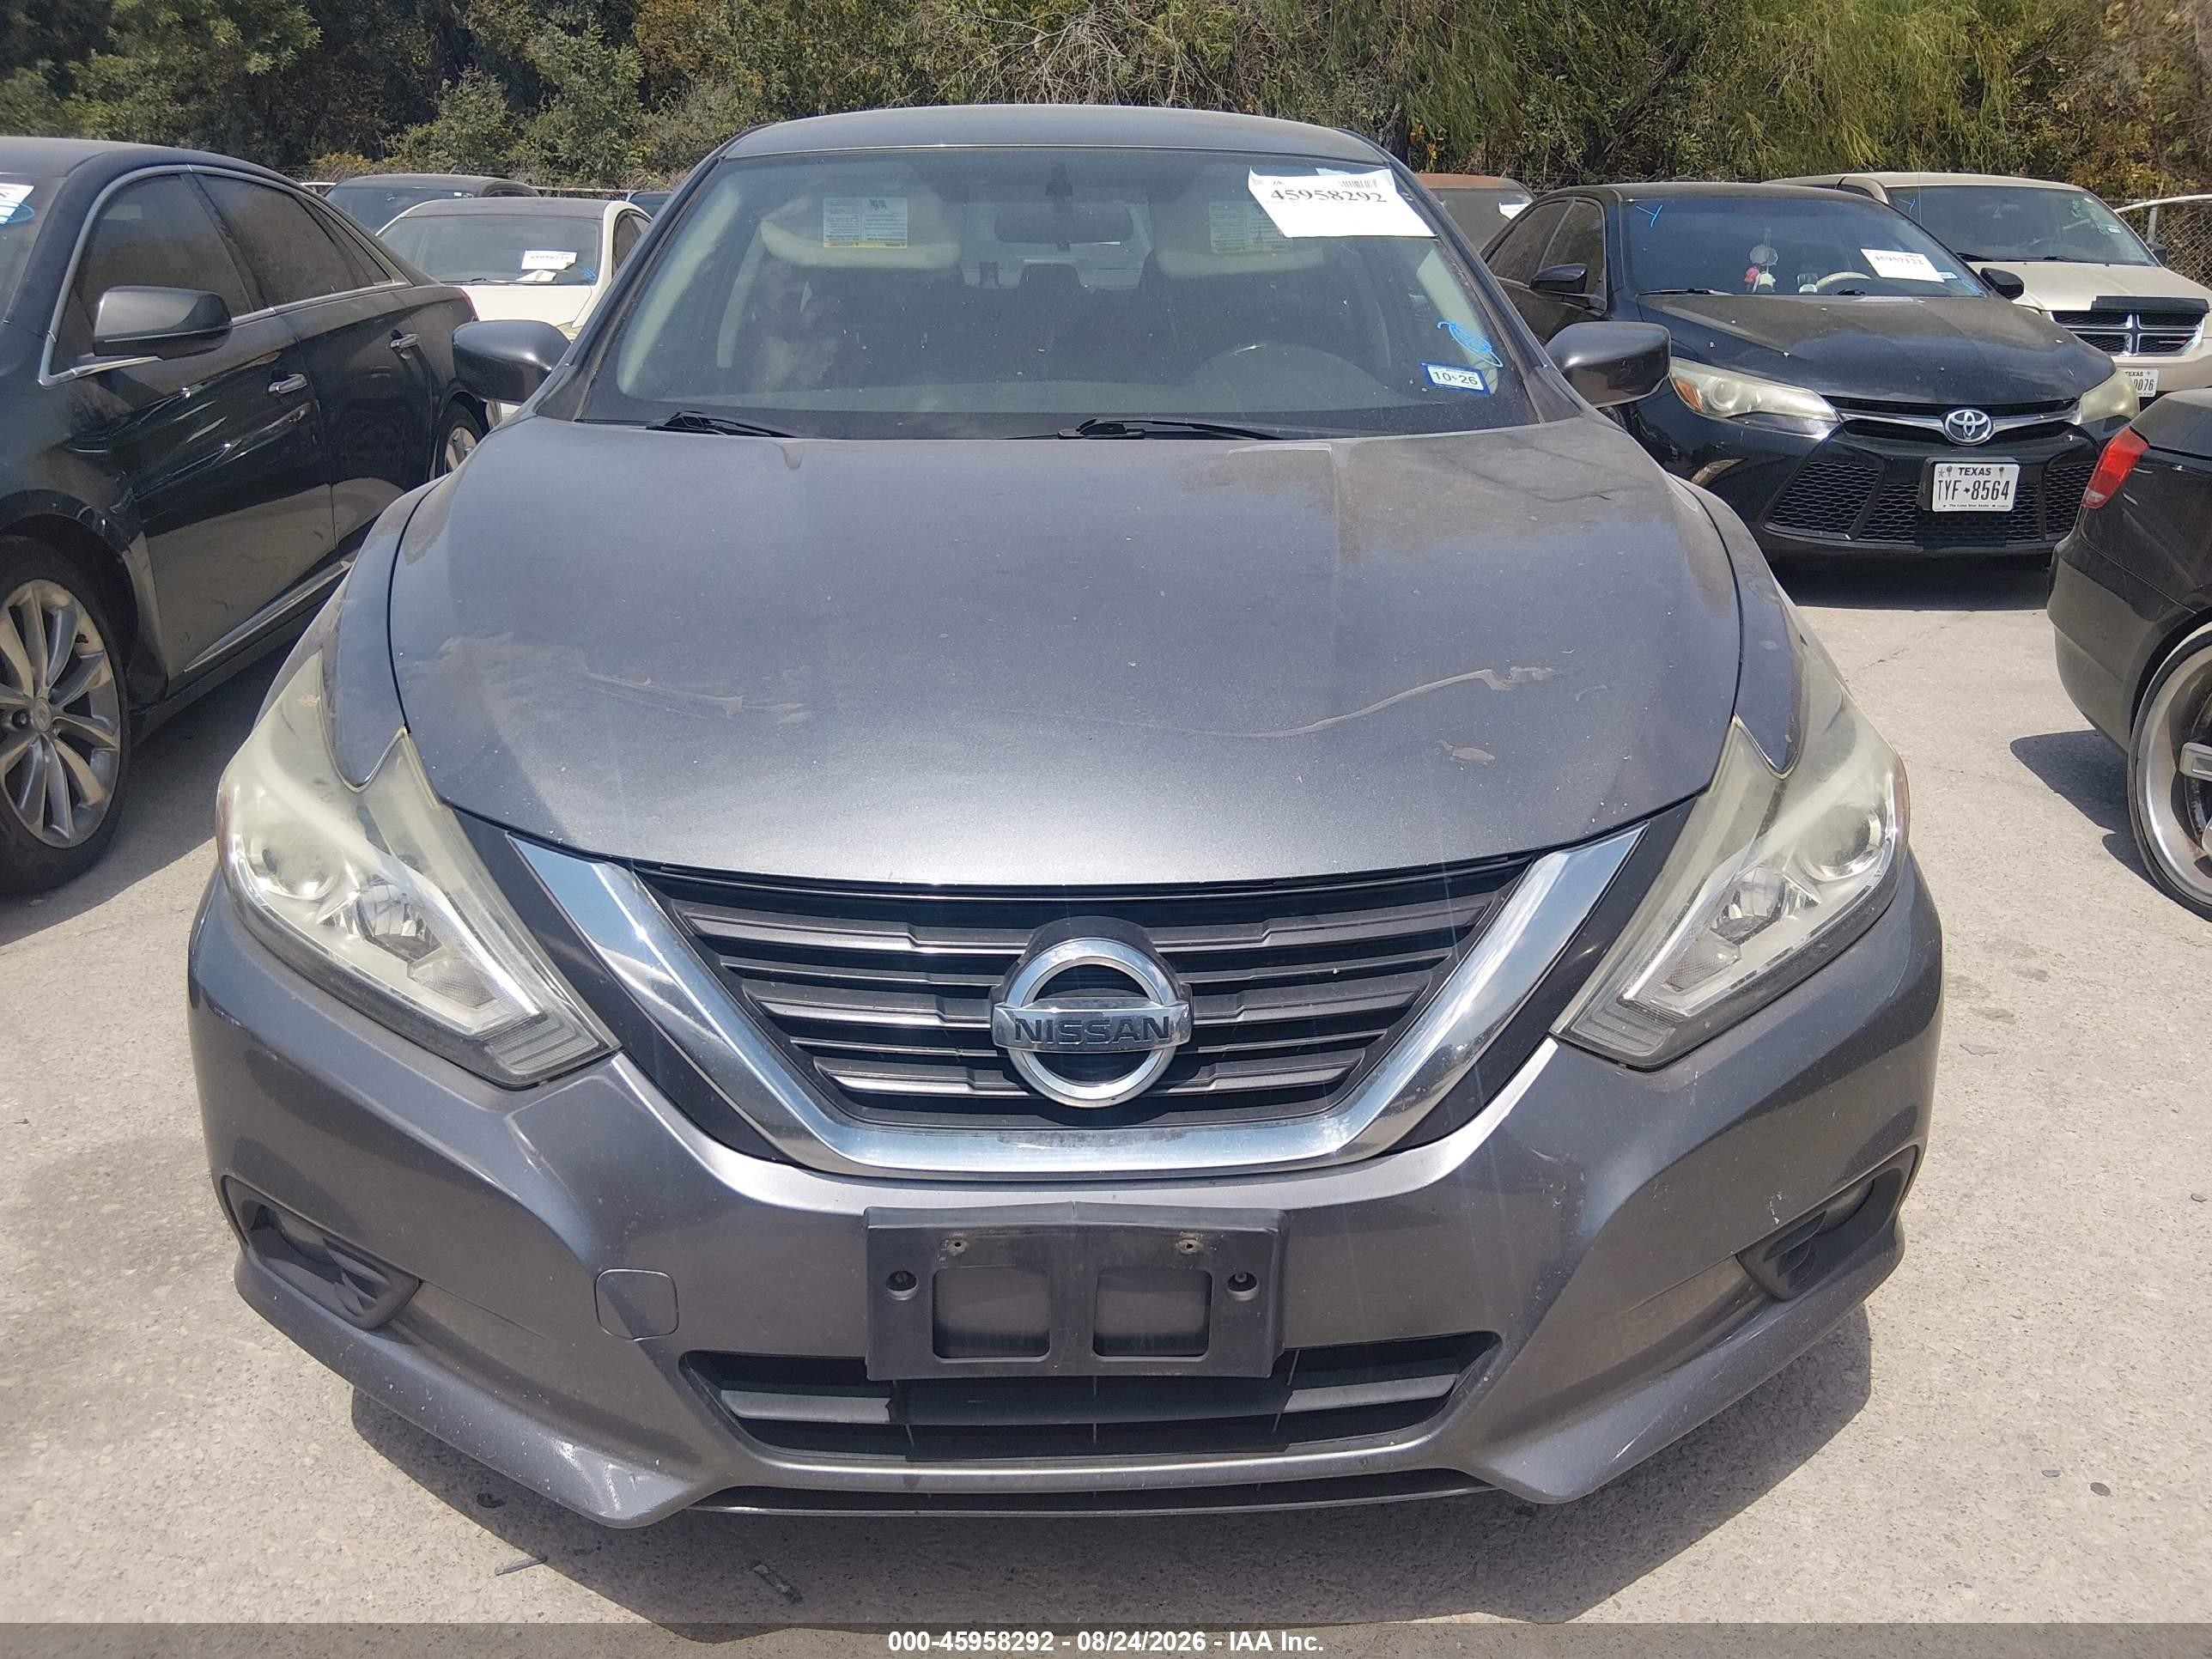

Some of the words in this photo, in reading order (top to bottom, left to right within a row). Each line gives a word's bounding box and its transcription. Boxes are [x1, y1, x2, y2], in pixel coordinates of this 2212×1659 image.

[1271, 189, 1388, 203] 45958292
[1958, 467, 1992, 477] TEXAS
[1014, 1016, 1170, 1045] NISSAN
